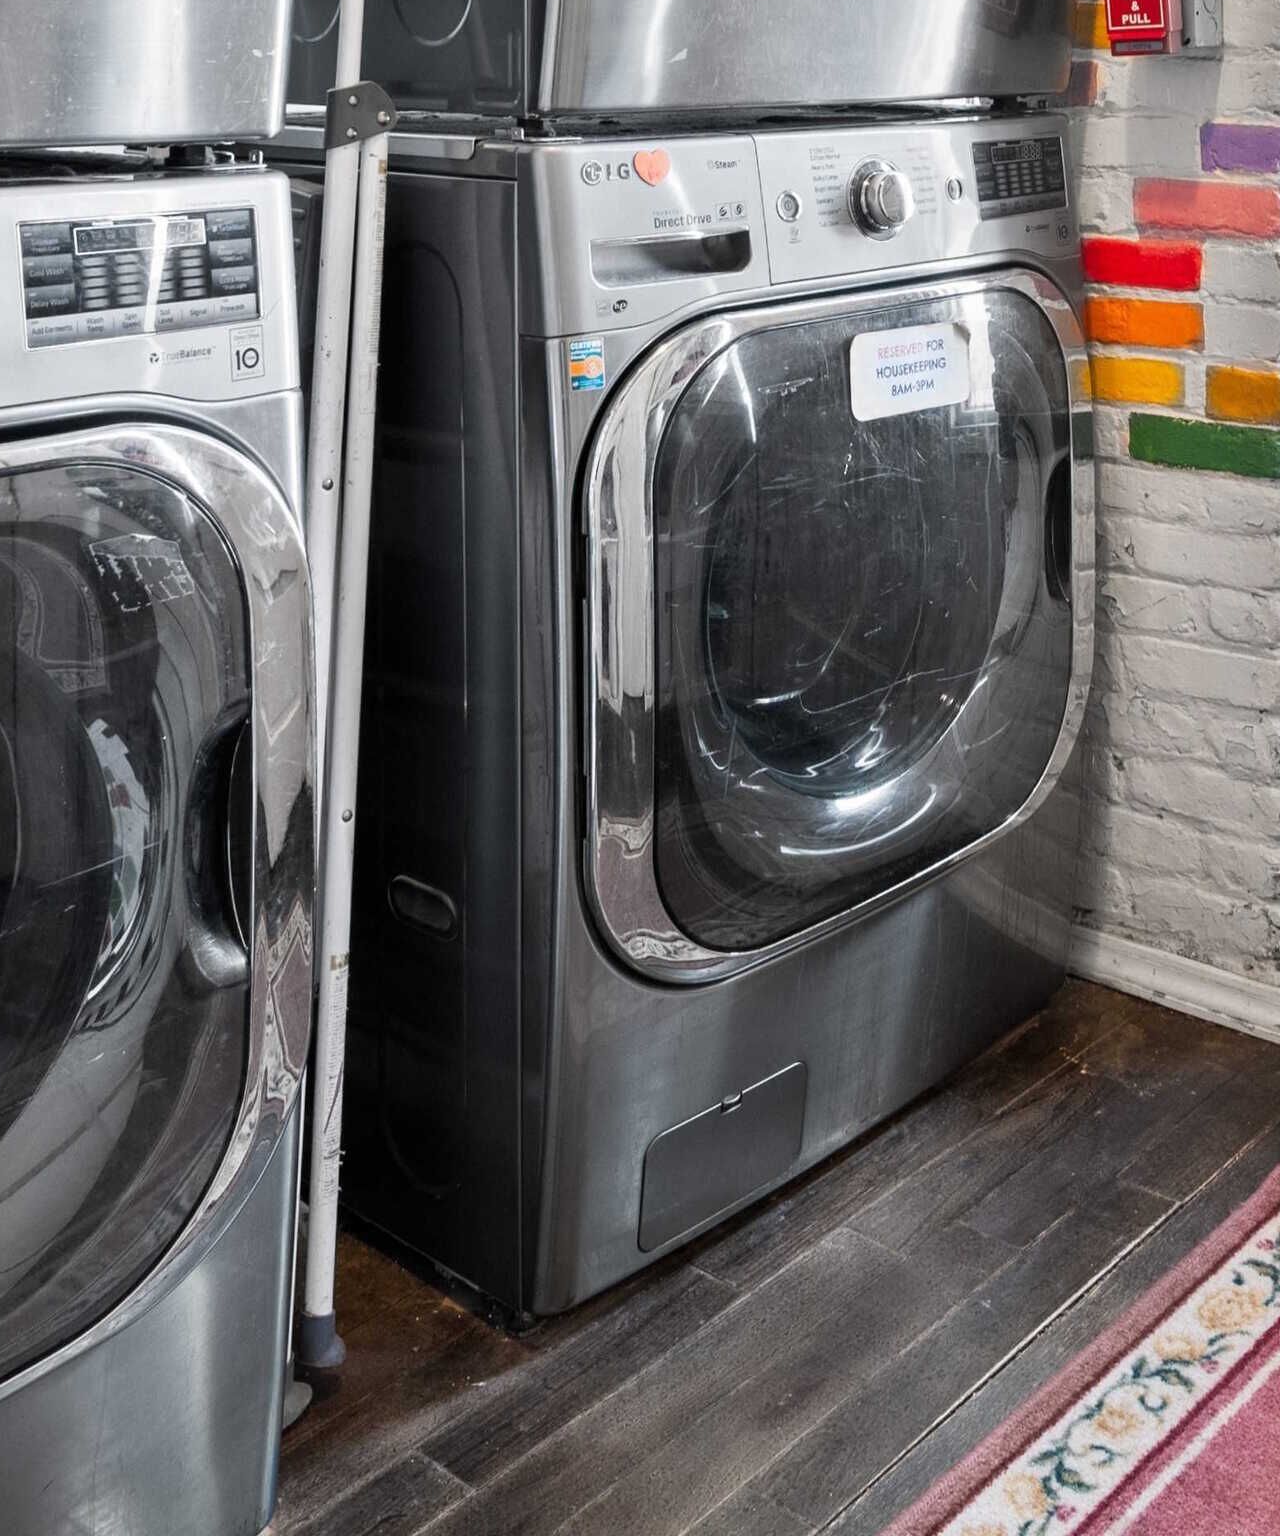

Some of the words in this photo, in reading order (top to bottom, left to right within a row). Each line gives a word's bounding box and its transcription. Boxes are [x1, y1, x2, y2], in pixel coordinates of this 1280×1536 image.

[1131, 1, 1140, 12] &
[1122, 13, 1151, 25] PULL
[606, 162, 630, 182] LG
[654, 215, 684, 229] Direct
[686, 214, 712, 226] Drive
[878, 342, 924, 361] RESERVED
[926, 338, 944, 351] FOR
[876, 357, 947, 379] HOUSEKEEPING
[891, 378, 935, 397] 8AM-3PM
